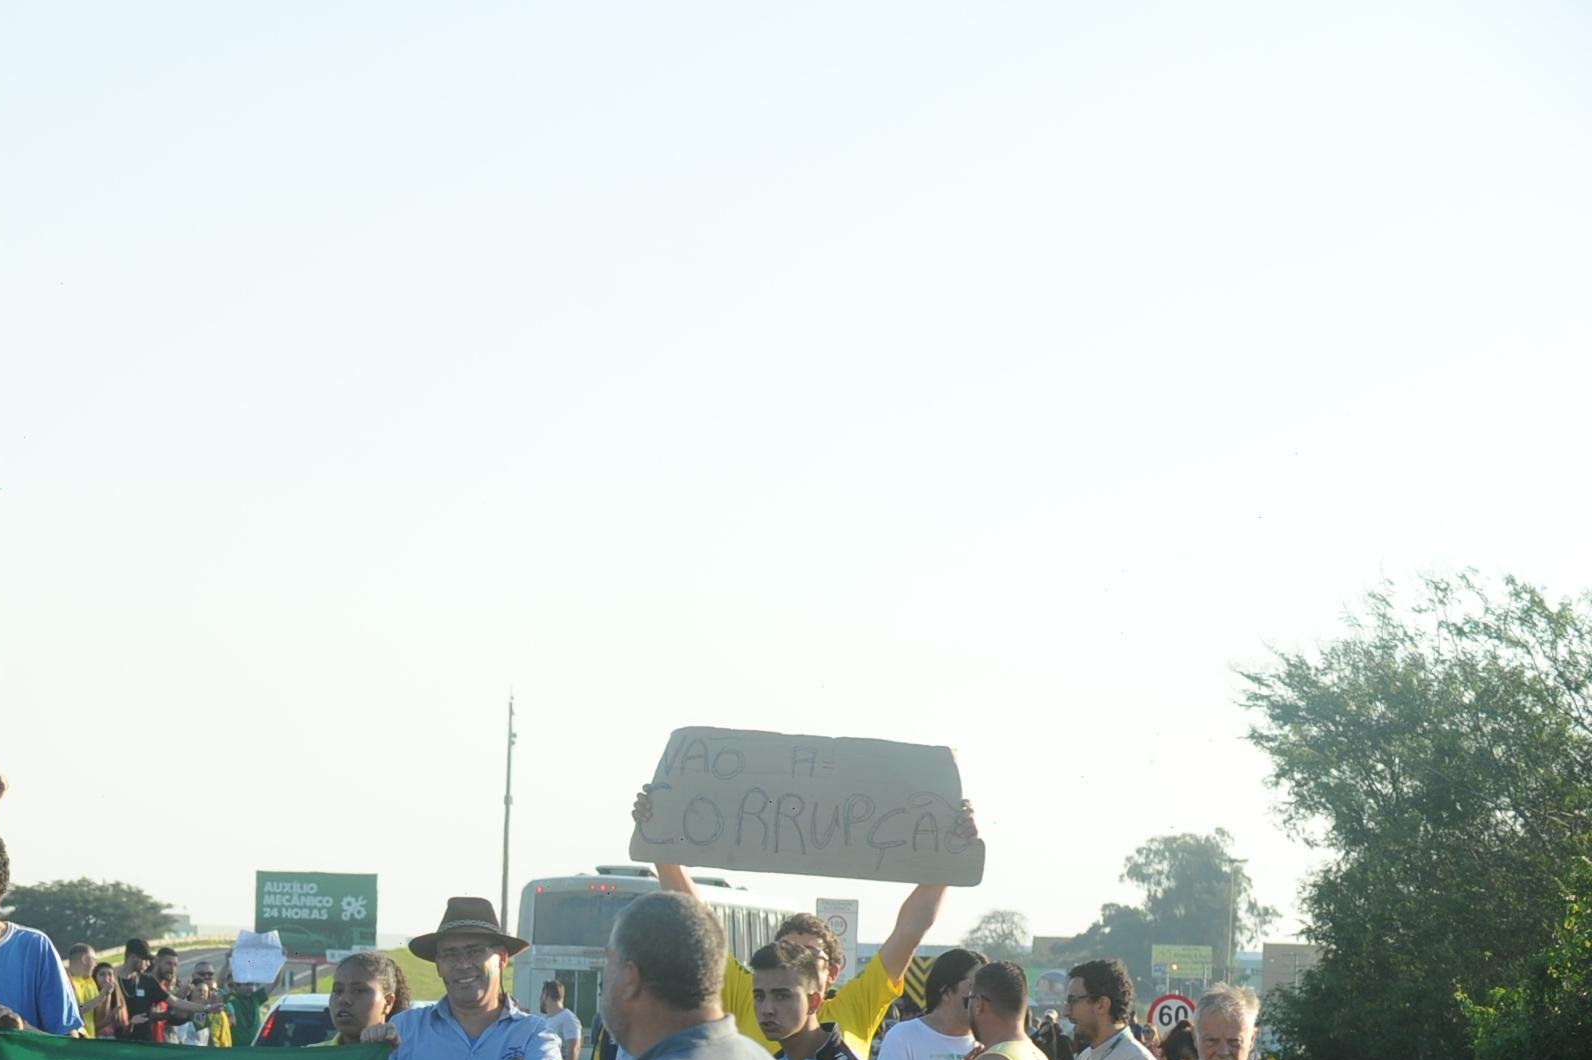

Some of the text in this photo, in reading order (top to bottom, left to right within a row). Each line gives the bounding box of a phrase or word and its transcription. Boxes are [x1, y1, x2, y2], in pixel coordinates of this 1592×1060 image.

[264, 880, 318, 894] AUXÍLIO
[263, 893, 334, 908] MECÂNICO
[263, 907, 328, 920] 24 HORAS
[1158, 1004, 1189, 1027] 60
